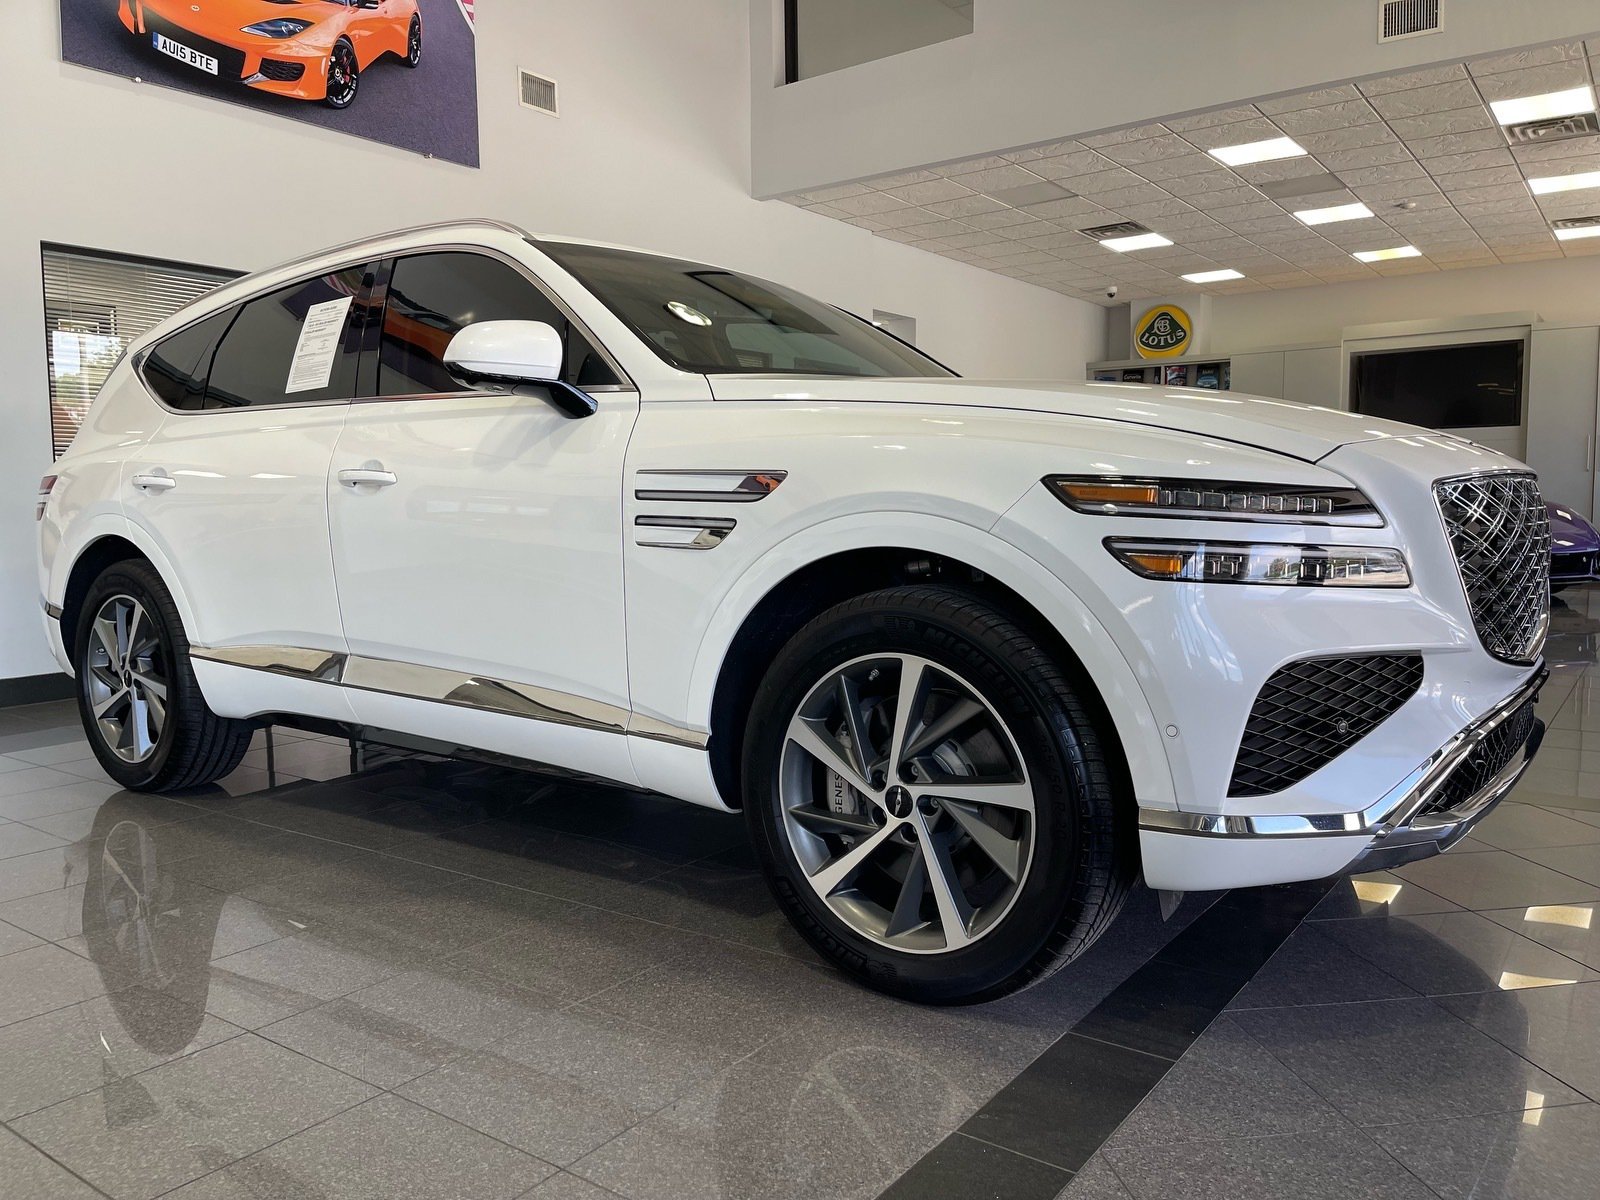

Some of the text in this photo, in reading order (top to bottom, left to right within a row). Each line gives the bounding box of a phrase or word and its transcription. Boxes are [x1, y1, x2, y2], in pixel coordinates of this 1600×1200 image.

[162, 39, 213, 70] AU15 BTE
[1141, 329, 1185, 346] LOTUS
